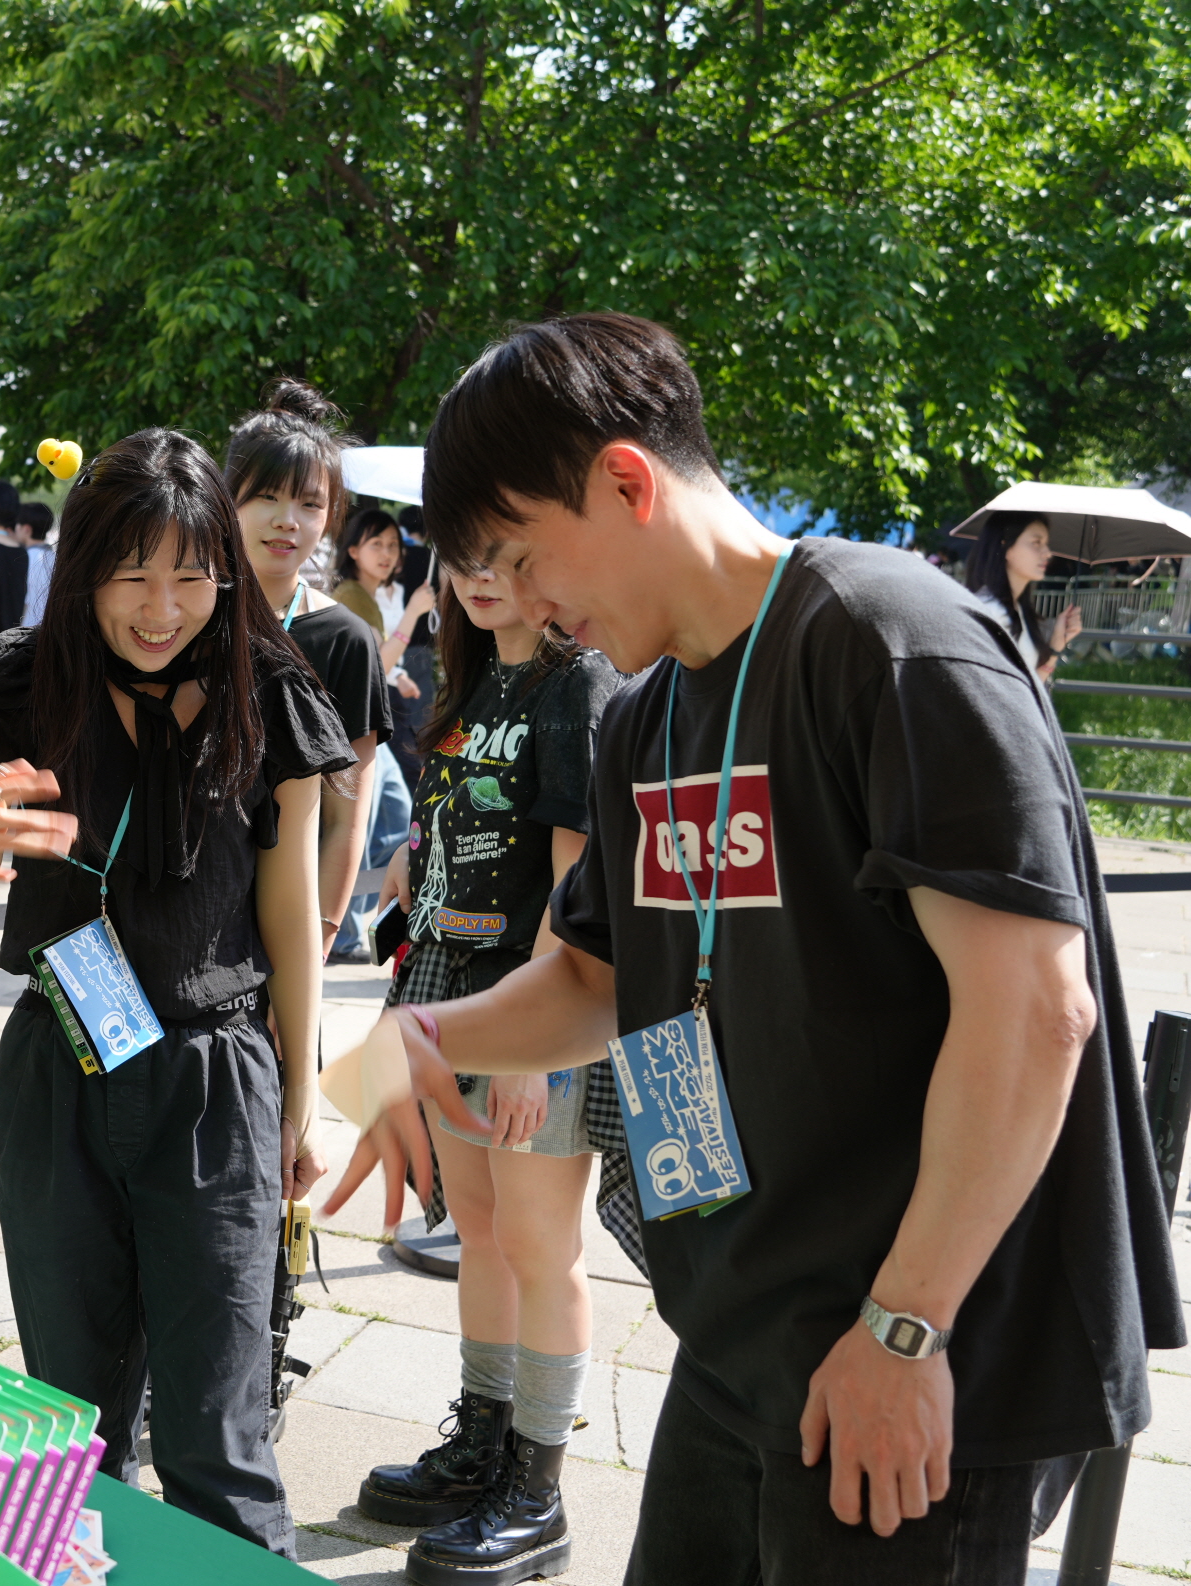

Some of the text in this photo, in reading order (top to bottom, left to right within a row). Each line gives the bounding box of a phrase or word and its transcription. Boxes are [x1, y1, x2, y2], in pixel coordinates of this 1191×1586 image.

[456, 840, 498, 855] is an alien
[438, 912, 501, 930] CLDPLY FM
[121, 980, 160, 1036] FESTIVAL
[694, 1096, 741, 1187] FESTIVAL
